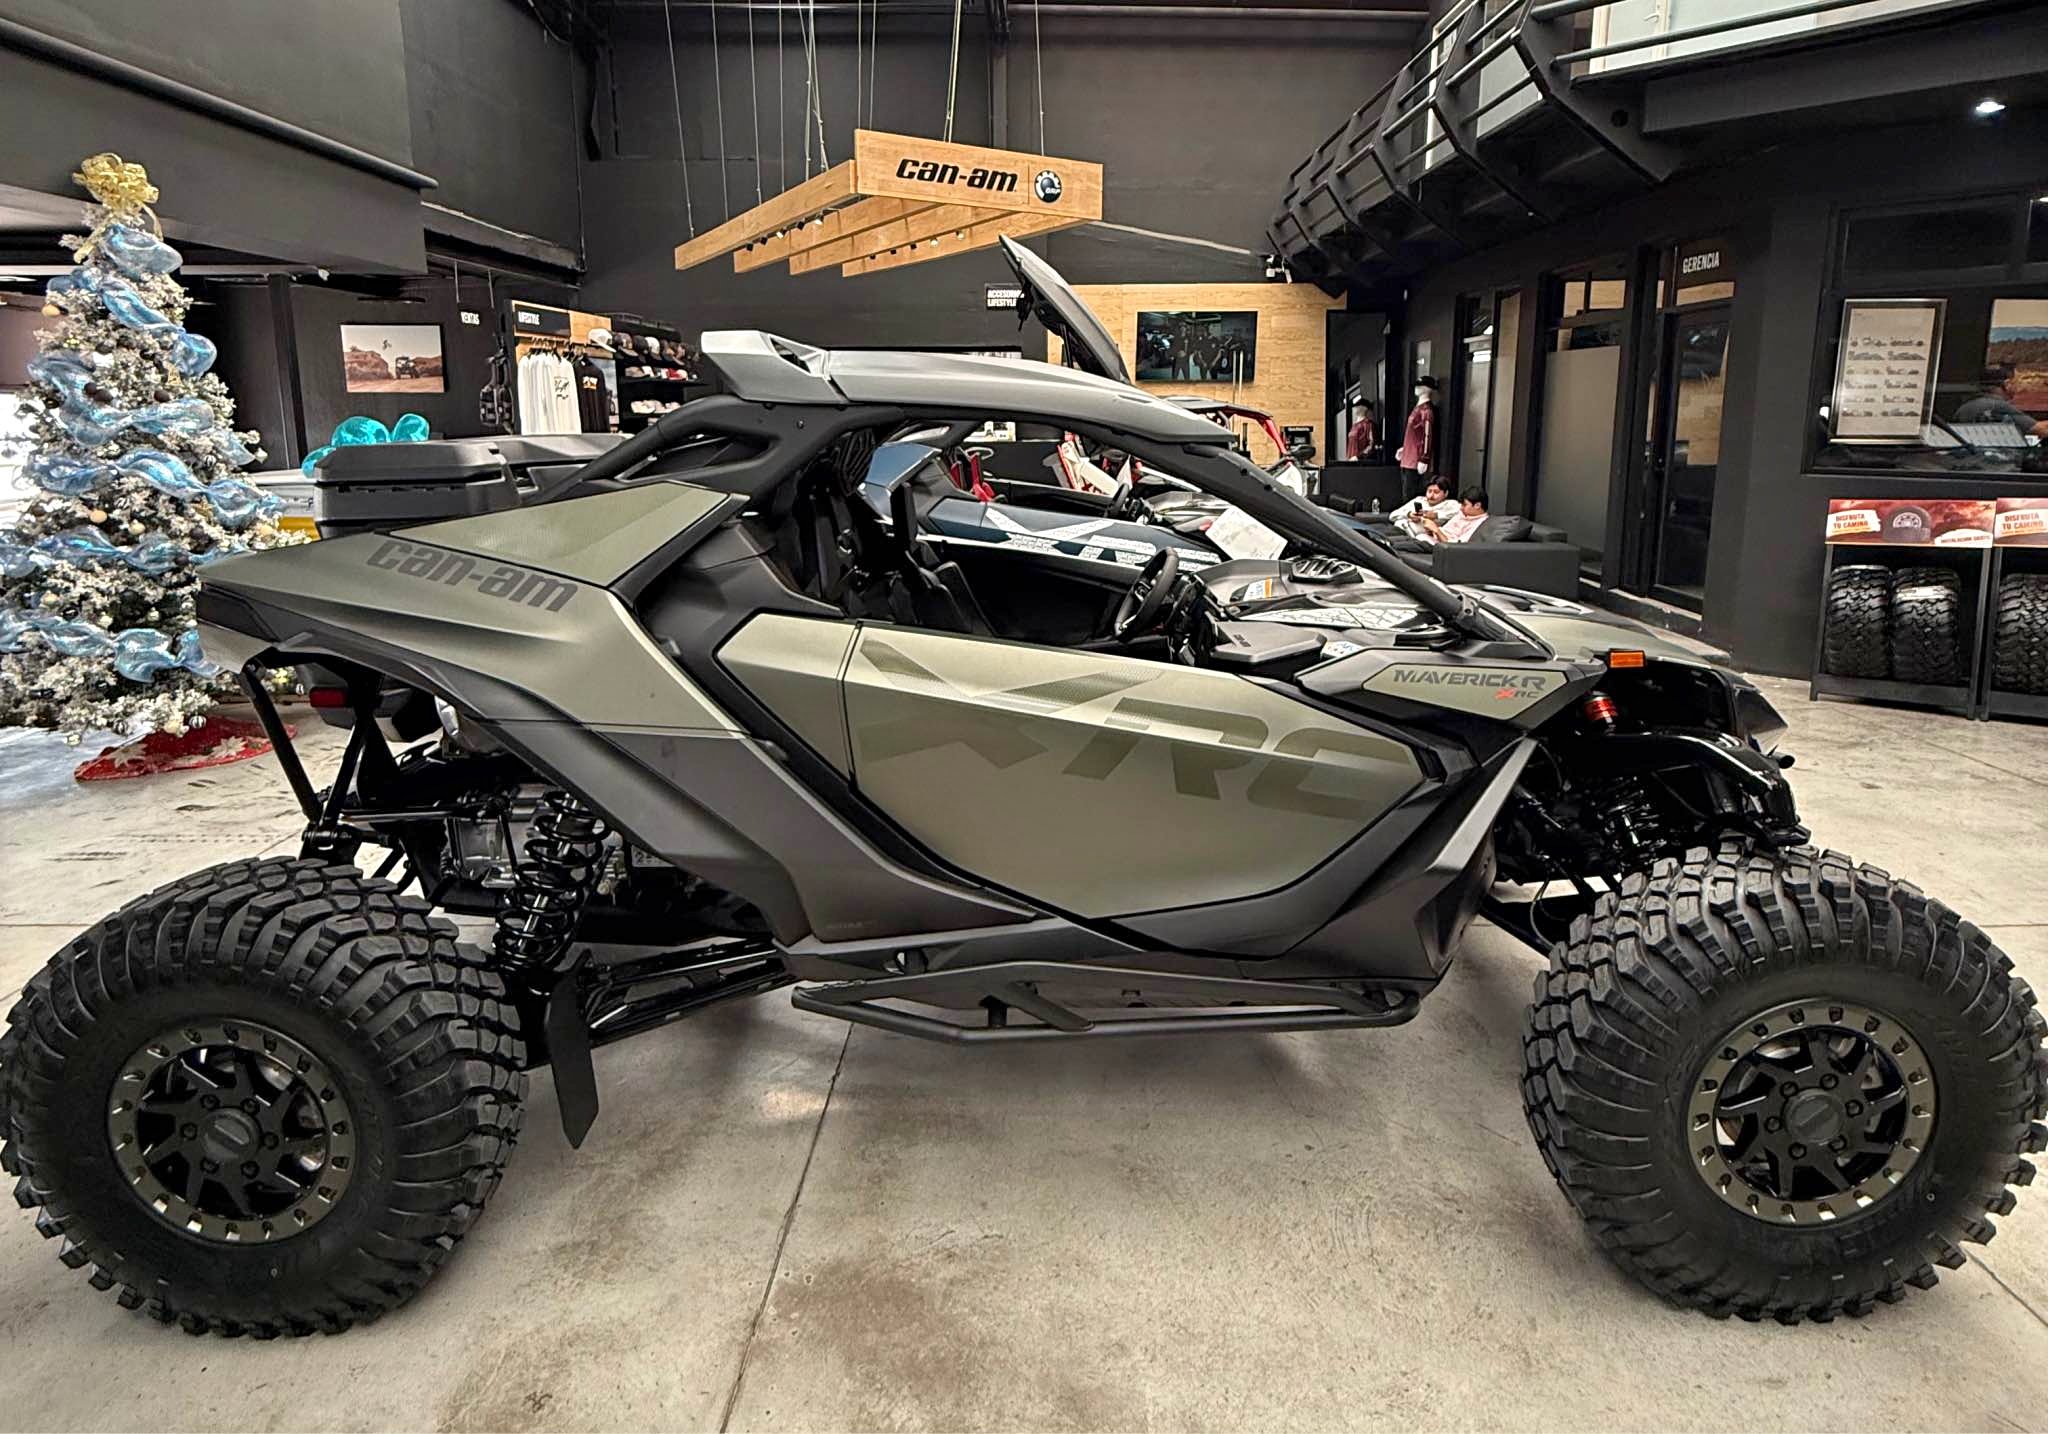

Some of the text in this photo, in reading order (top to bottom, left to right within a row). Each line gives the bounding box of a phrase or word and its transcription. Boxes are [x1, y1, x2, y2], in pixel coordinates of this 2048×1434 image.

[896, 158, 1018, 192] can-am
[1683, 251, 1720, 274] GERENCIA
[1835, 513, 1865, 522] DISFRUTA
[1843, 520, 1869, 528] CAMINO
[2004, 512, 2040, 522] DISFRUTA
[2014, 520, 2044, 528] CAMINO
[366, 539, 579, 612] can-am
[1393, 669, 1547, 691] MAVERICK R
